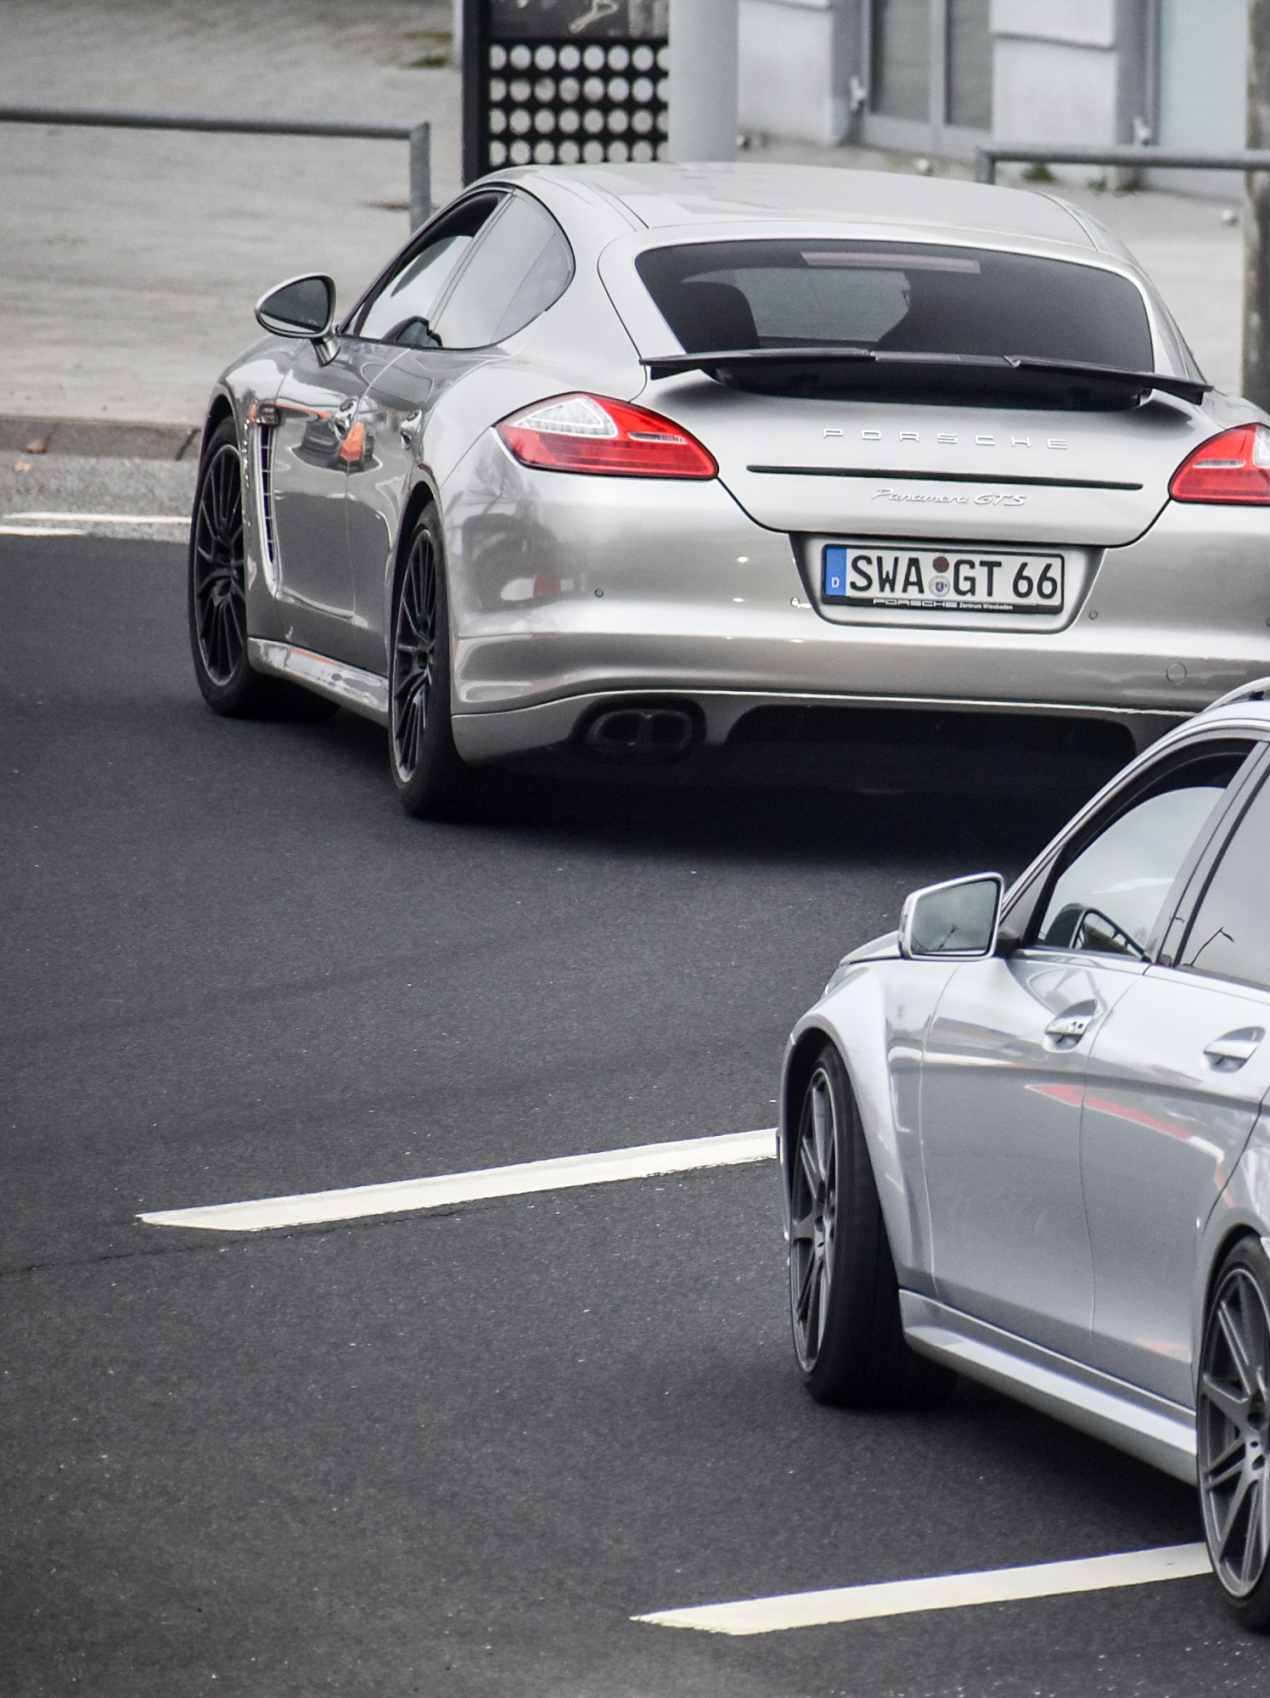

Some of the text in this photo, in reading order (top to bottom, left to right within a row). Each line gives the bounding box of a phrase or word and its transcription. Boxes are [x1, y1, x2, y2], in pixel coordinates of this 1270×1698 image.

[823, 428, 1068, 450] PORSCHE
[871, 488, 1027, 507] Panamera GTS
[831, 554, 1058, 599] D SWA GT 66
[873, 598, 958, 609] PORSCHE
